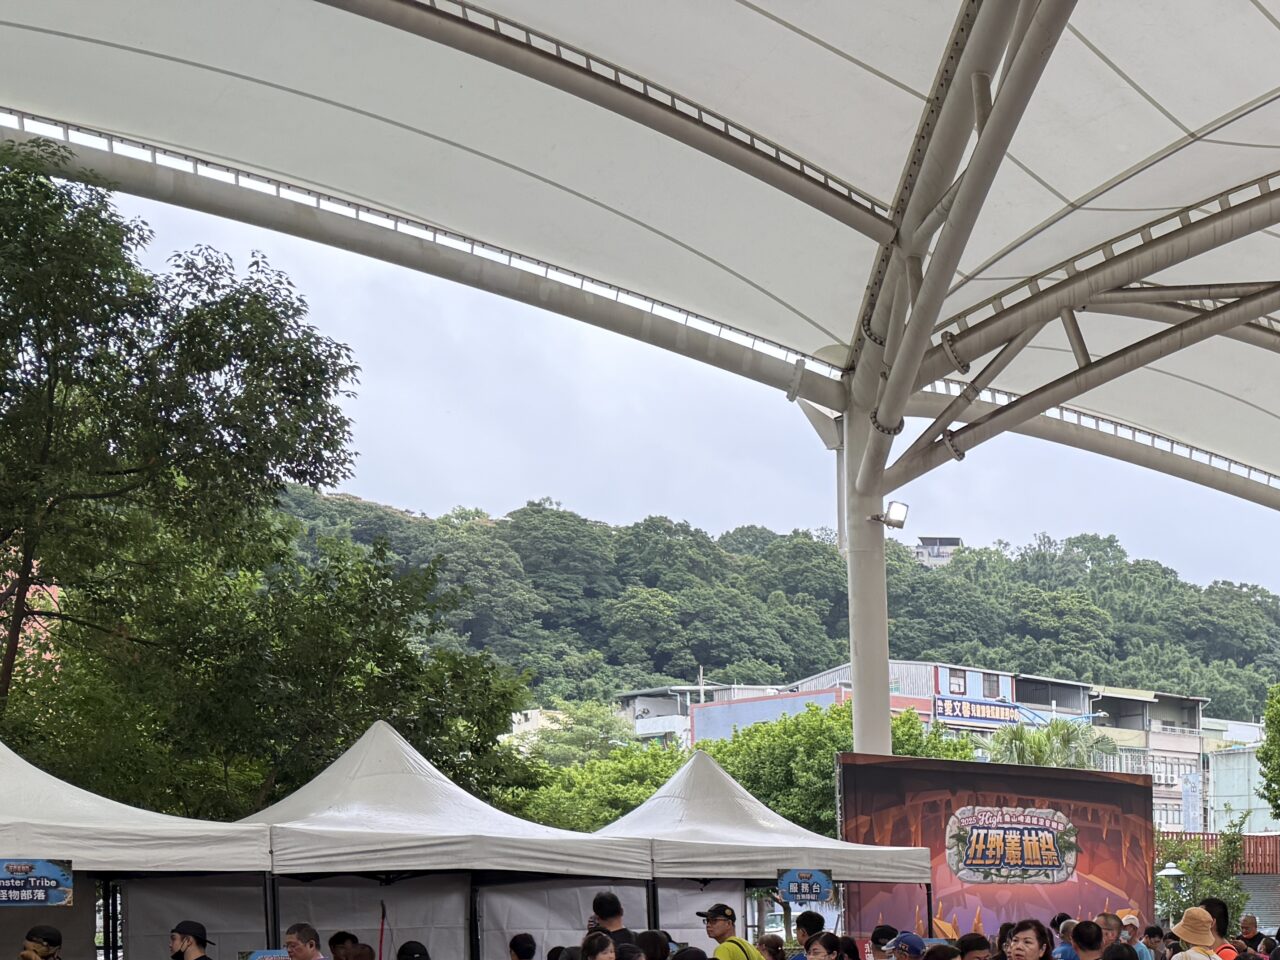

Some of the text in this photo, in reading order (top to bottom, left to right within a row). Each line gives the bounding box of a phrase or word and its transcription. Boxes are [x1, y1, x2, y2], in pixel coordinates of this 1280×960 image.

[961, 816, 977, 826] 2025
[977, 810, 1003, 828] High
[28, 877, 57, 887] Tribe
[789, 882, 820, 893] 服務台
